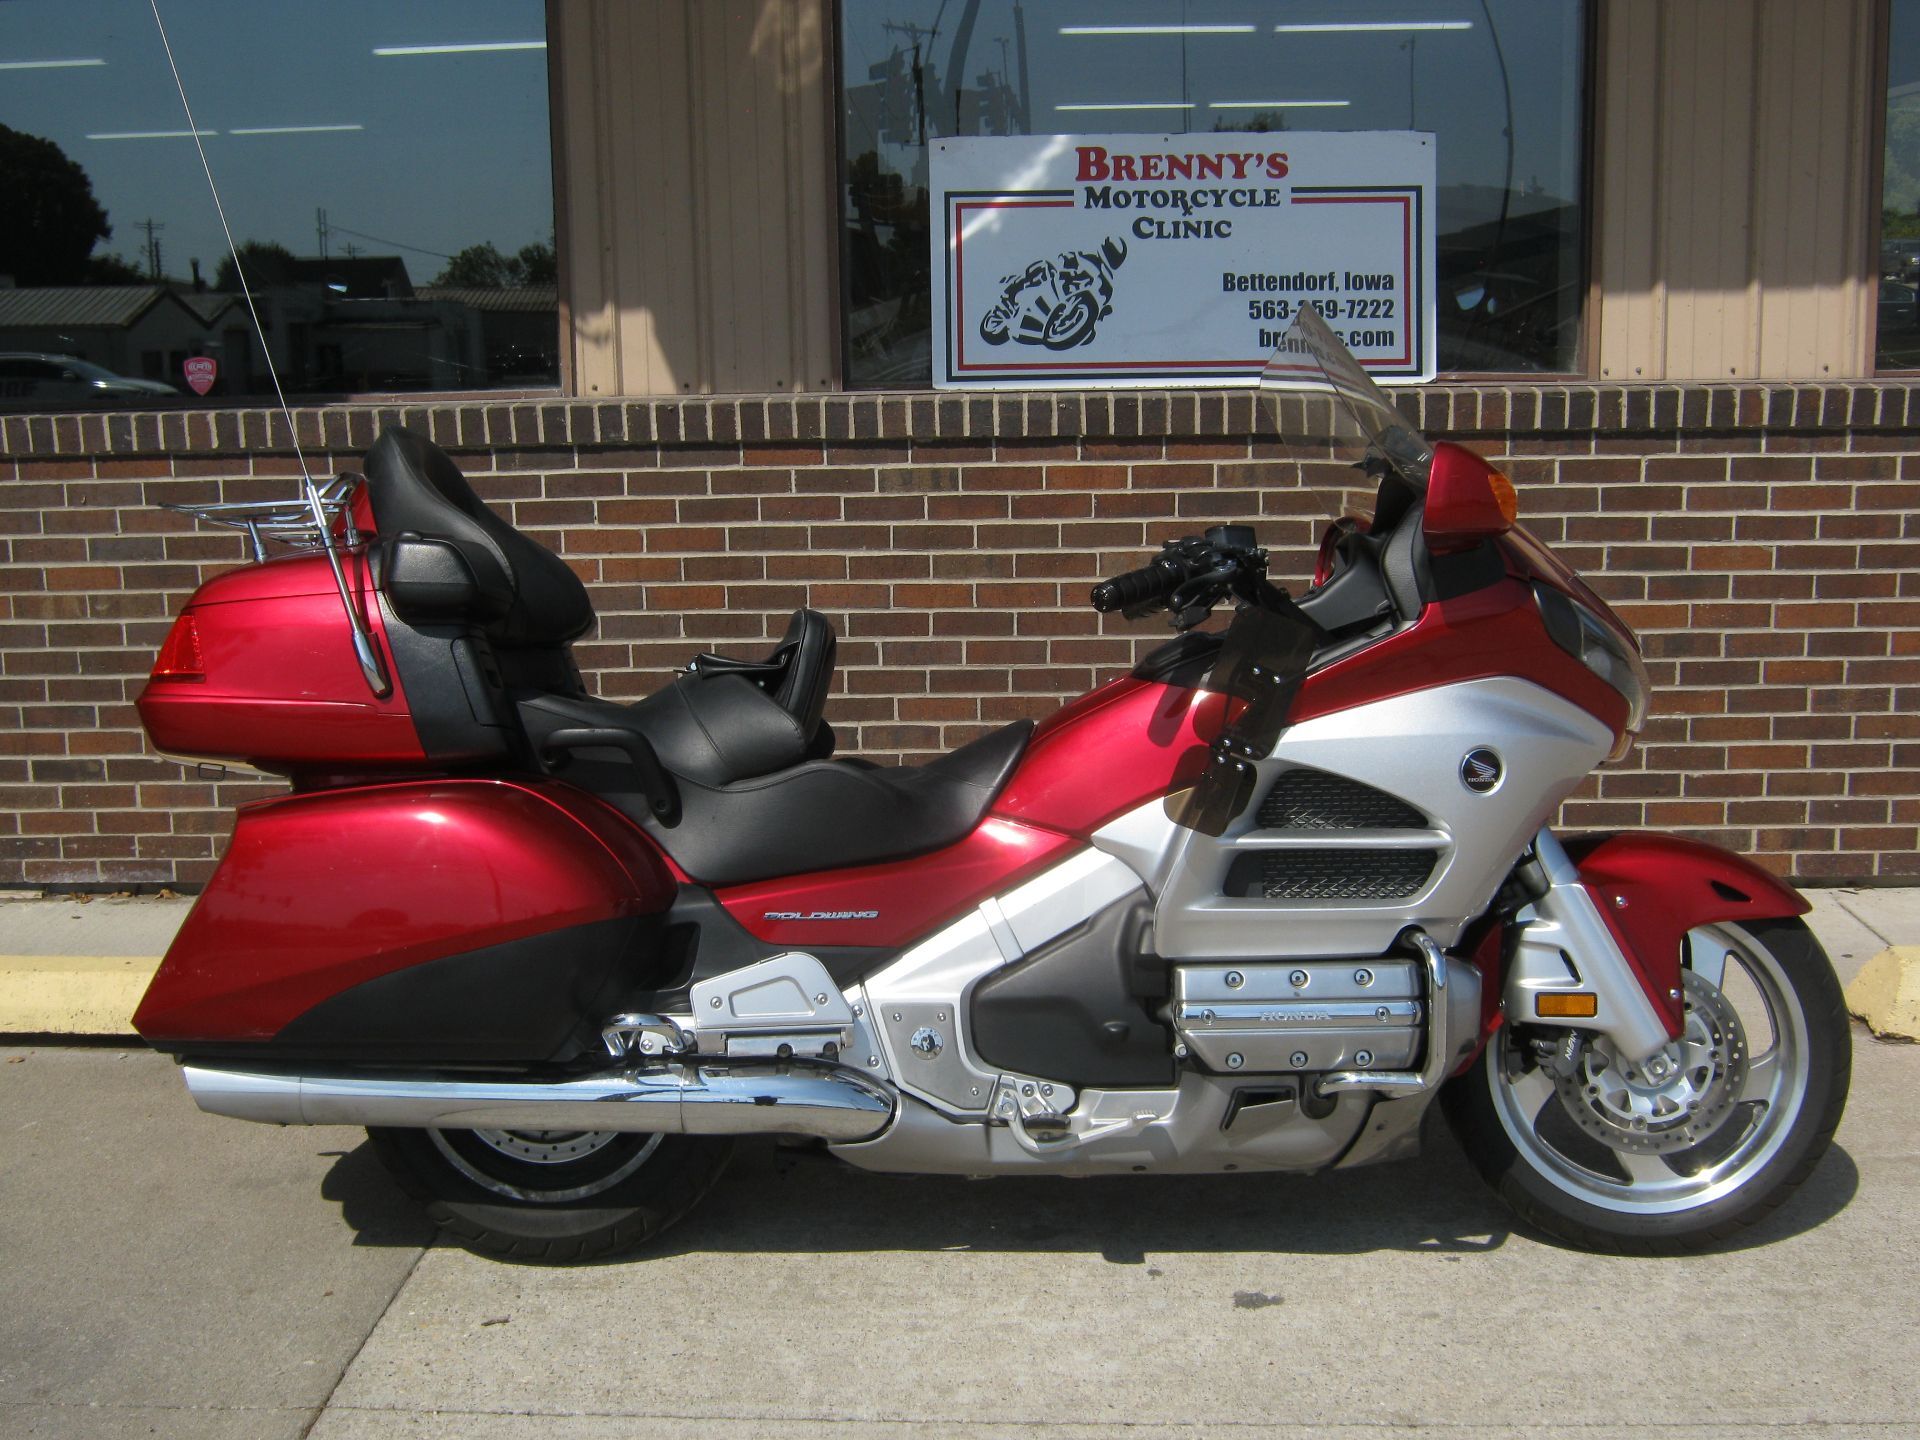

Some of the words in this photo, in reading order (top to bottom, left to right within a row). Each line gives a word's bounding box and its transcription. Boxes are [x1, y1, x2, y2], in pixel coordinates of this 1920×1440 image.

[1075, 146, 1289, 181] BRENNY'S
[1084, 186, 1281, 215] MOTORCYCLE
[1132, 216, 1232, 239] CLINIC
[1222, 272, 1339, 292] Bettendorf,
[1344, 272, 1395, 291] Iowa
[1258, 328, 1395, 348] brs.com
[1260, 1011, 1332, 1021] HONDA
